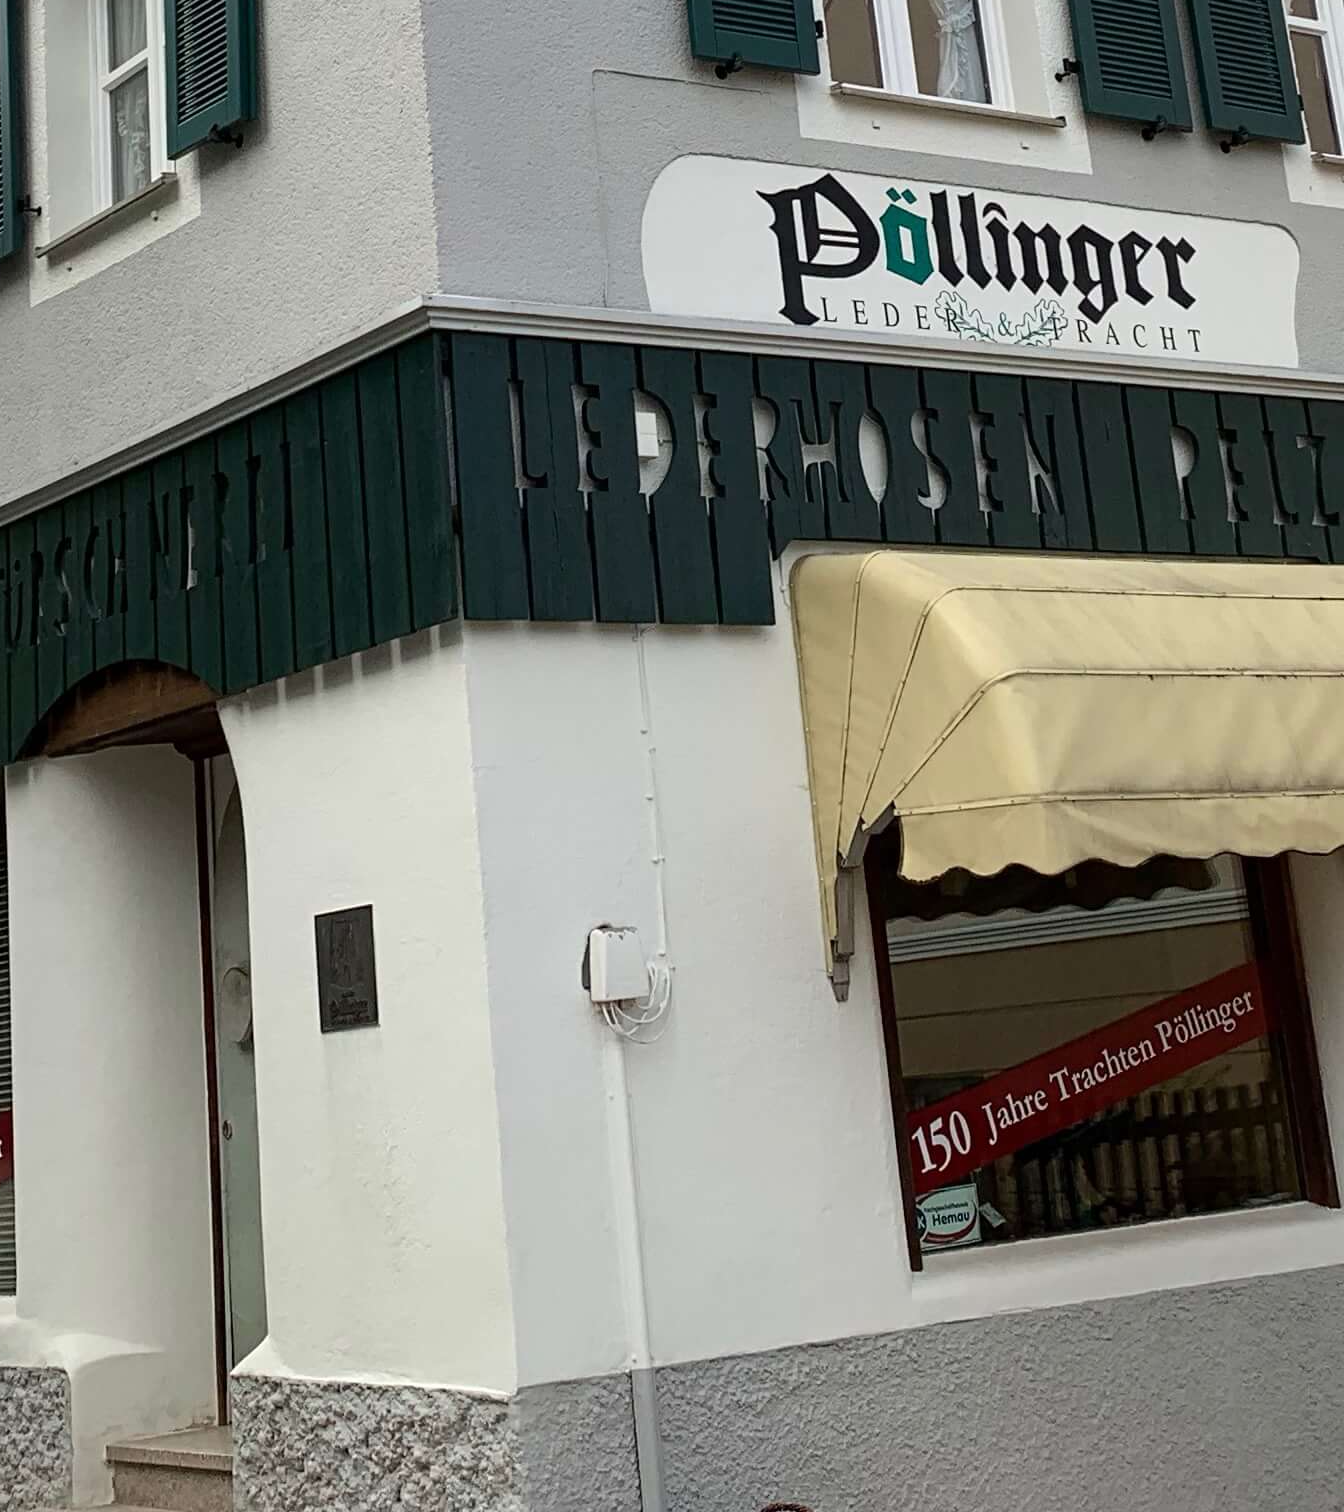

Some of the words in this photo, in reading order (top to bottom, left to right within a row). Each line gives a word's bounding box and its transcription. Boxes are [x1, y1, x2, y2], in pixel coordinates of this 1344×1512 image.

[756, 174, 1196, 326] Pöllinger
[819, 296, 958, 333] LEDER
[997, 313, 1015, 337] &
[1049, 315, 1202, 354] TRACHT
[509, 377, 1060, 515] LEDERHOSEN
[911, 1110, 972, 1174] 150
[982, 1088, 1049, 1144] Jahre
[1049, 1039, 1157, 1103] Trachten
[1155, 991, 1254, 1054] Pöllinger
[932, 1212, 970, 1226] Hemau
